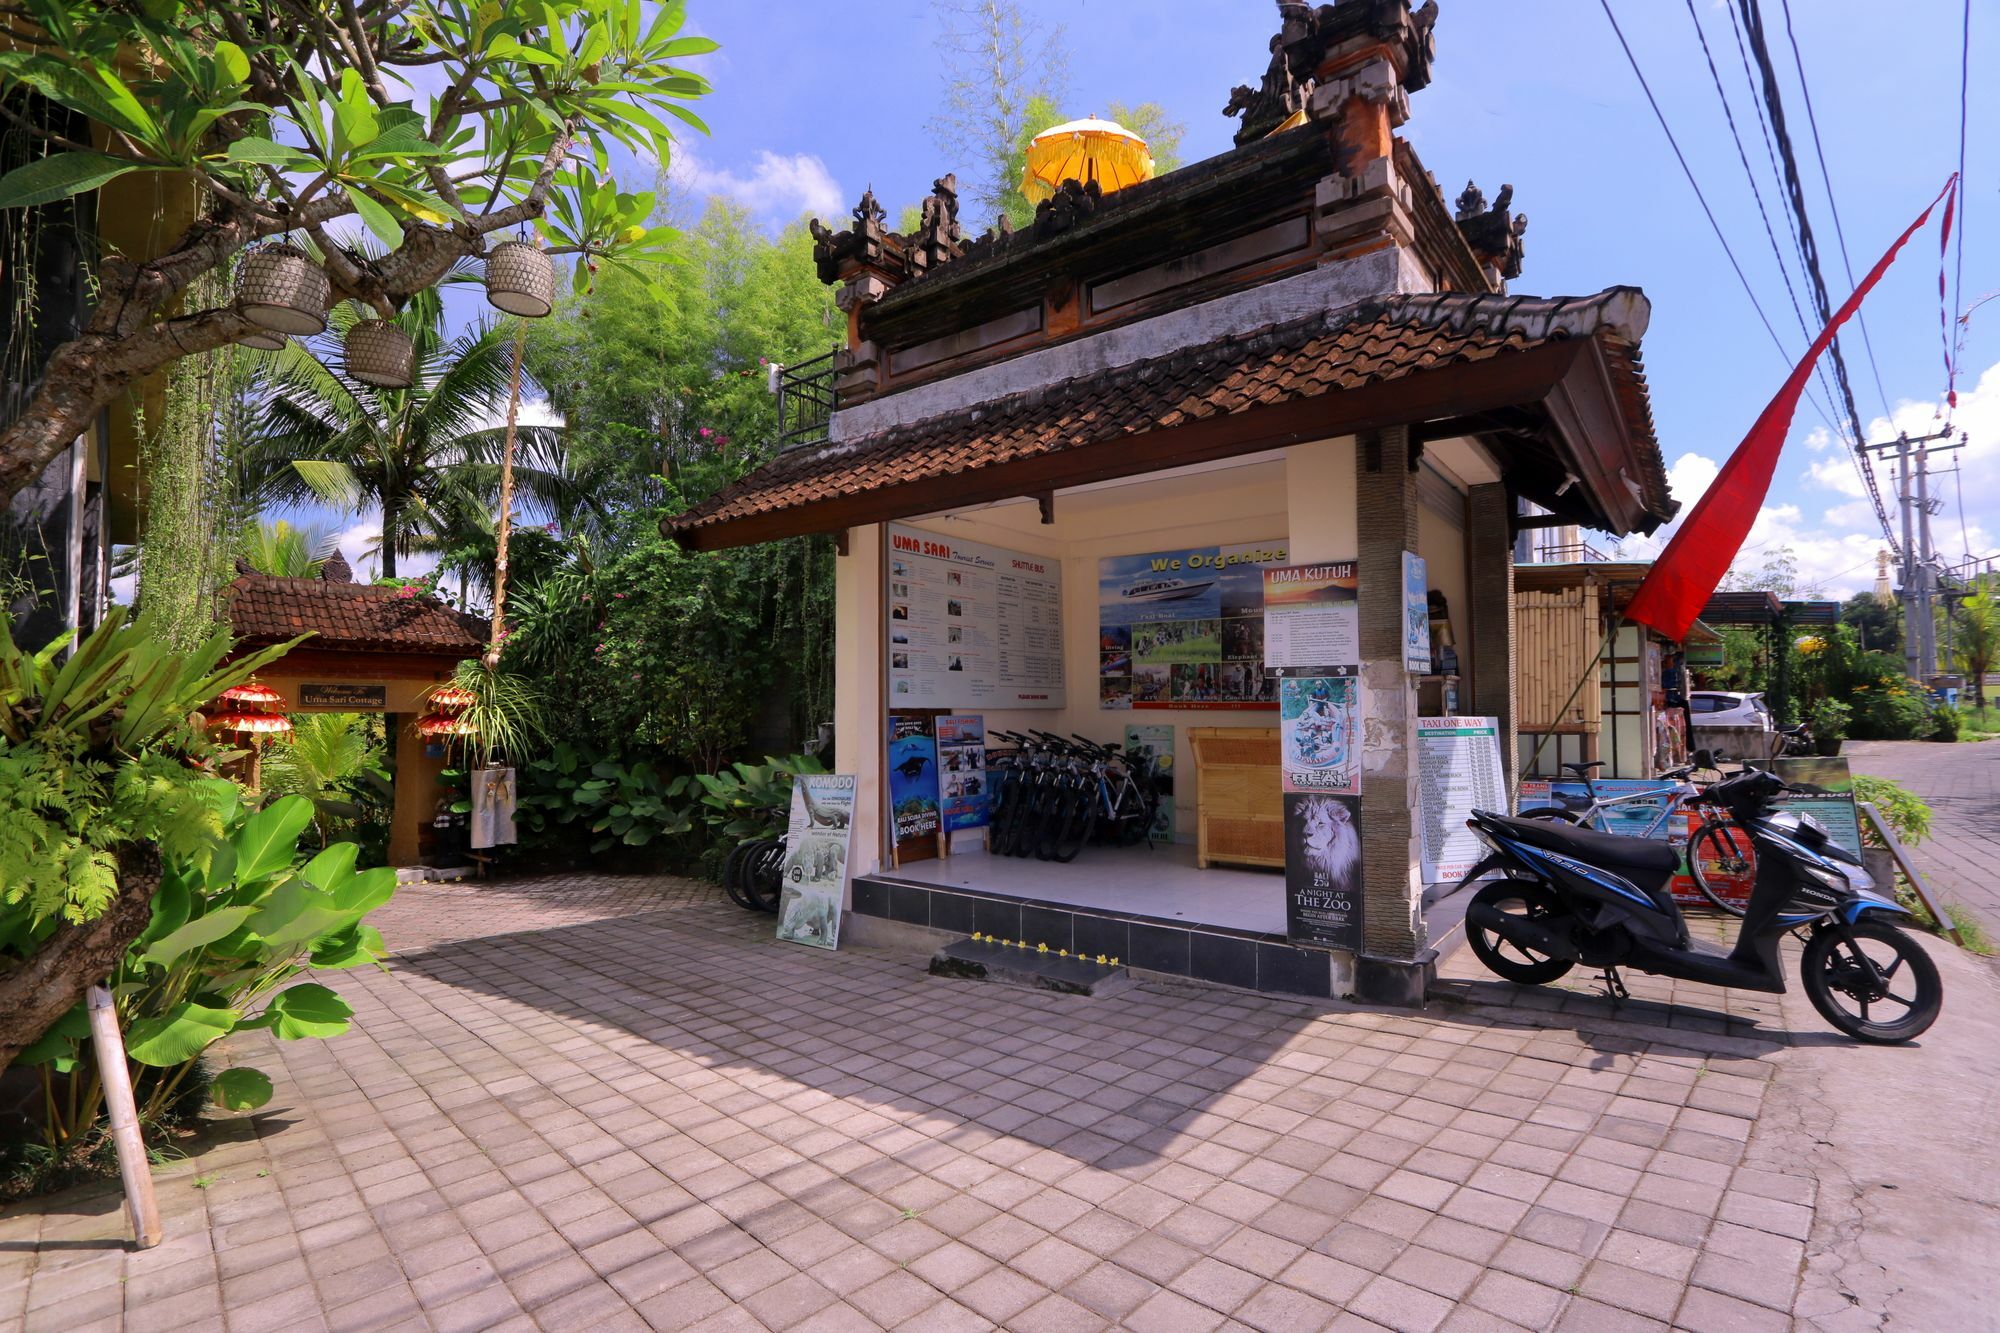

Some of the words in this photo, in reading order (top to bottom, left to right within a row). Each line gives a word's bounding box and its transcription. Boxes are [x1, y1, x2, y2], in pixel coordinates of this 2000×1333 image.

[893, 535, 920, 552] UMA
[923, 541, 950, 559] SARI
[1151, 558, 1182, 572] We
[1187, 548, 1288, 570] Organize
[1034, 564, 1045, 574] BUS
[1271, 569, 1300, 584] UMA
[1304, 564, 1352, 580] KUTUH
[305, 695, 328, 704] Uma
[329, 695, 347, 704] Sari
[348, 695, 383, 705] Cottage
[1421, 719, 1441, 728] TAXI
[1444, 719, 1463, 728] ONE
[1464, 718, 1484, 727] WAY
[809, 776, 853, 789] KOMODO
[1292, 772, 1348, 783] REAL
[899, 824, 920, 836] BOOK
[920, 820, 937, 831] HERE
[1442, 871, 1463, 879] BOOK
[1313, 879, 1330, 887] ZOO
[1306, 889, 1334, 898] NIGHT
[1801, 887, 1838, 903] HONDA
[1294, 893, 1320, 908] THE
[1322, 897, 1351, 911] ZOO
